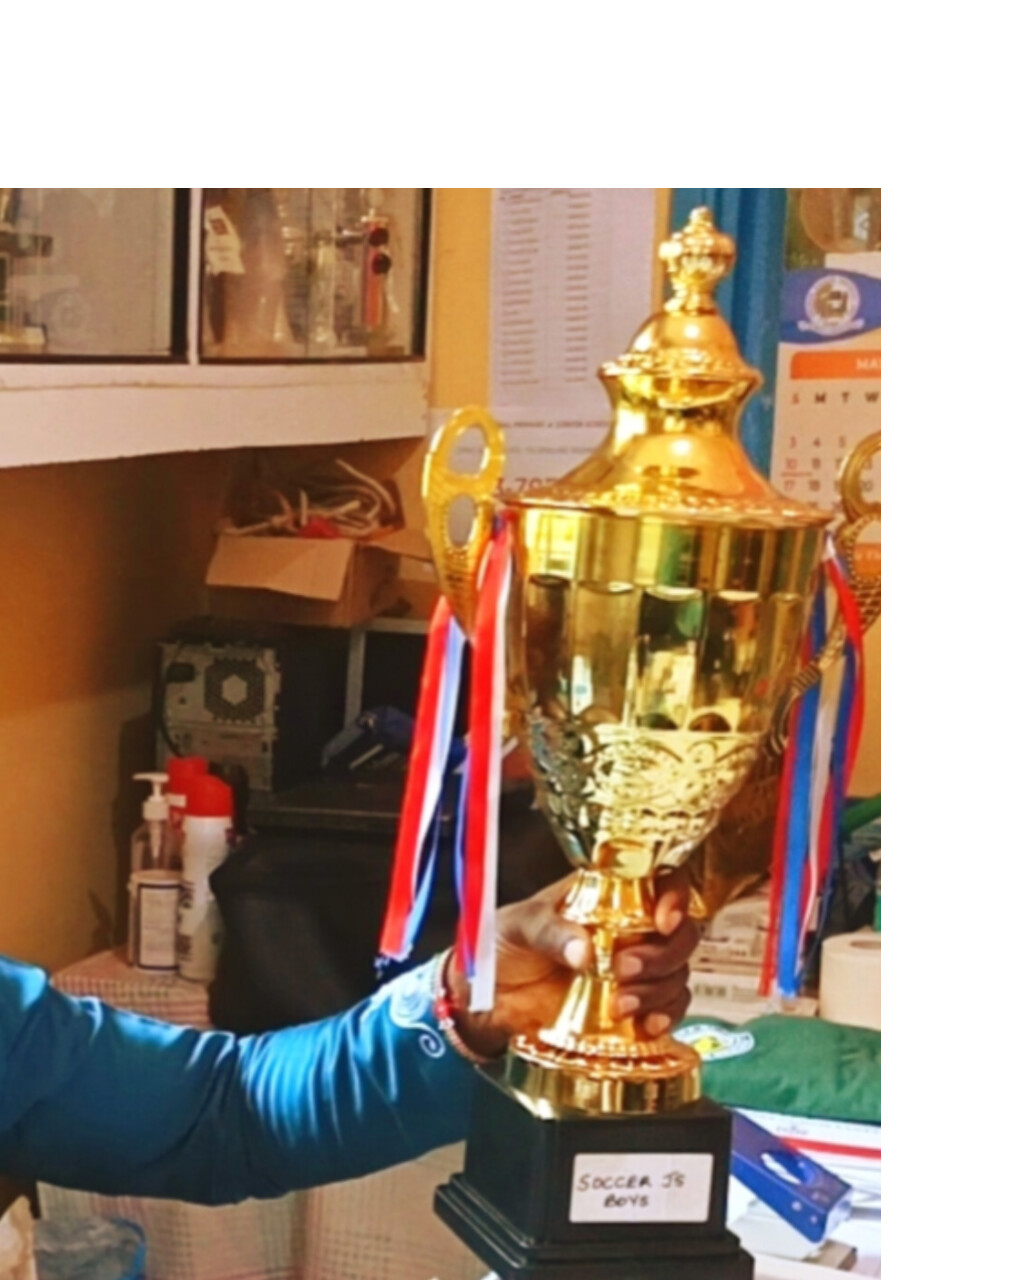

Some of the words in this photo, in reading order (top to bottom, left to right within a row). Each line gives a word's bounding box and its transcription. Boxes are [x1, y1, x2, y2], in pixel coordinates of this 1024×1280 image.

[815, 391, 826, 404] M
[841, 391, 850, 404] T
[864, 391, 879, 403] W
[577, 1173, 651, 1192] SOCCER
[604, 1193, 649, 1208] BOYS
